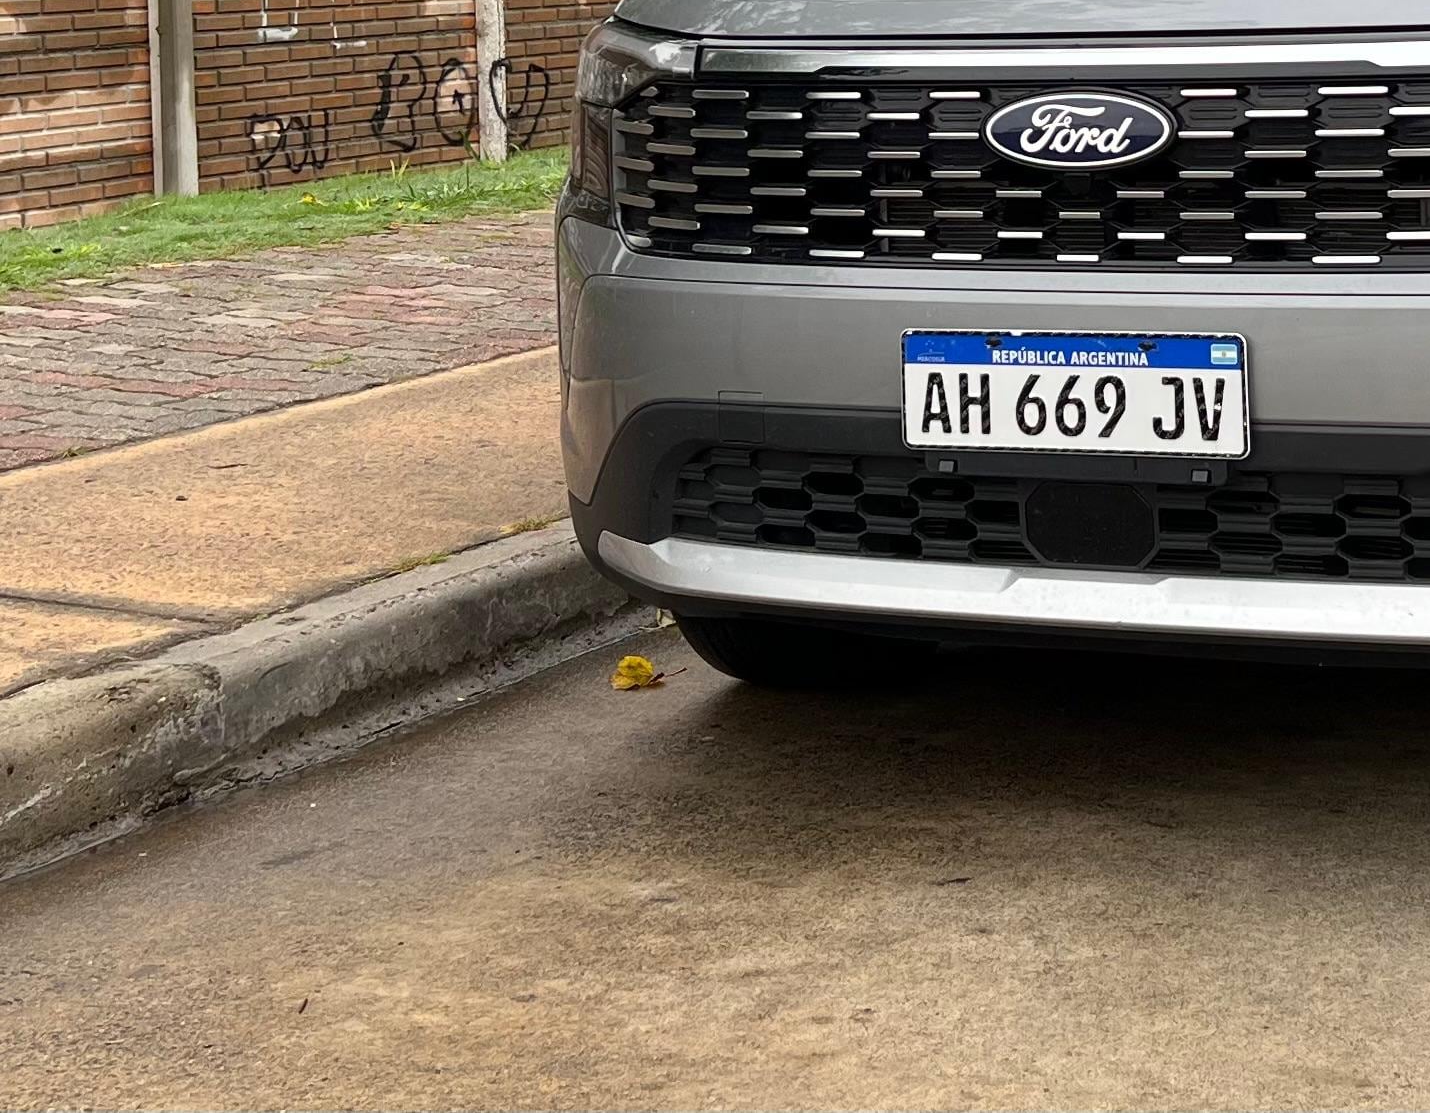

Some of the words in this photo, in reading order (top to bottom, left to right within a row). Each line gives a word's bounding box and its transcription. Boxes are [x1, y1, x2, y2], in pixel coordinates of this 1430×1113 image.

[1019, 103, 1134, 154] Ford
[992, 346, 1066, 365] REPÚBLICA
[1070, 350, 1149, 367] ARGENTINA
[921, 372, 991, 435] AH
[1015, 374, 1127, 438] 669
[1152, 376, 1226, 441] JV
